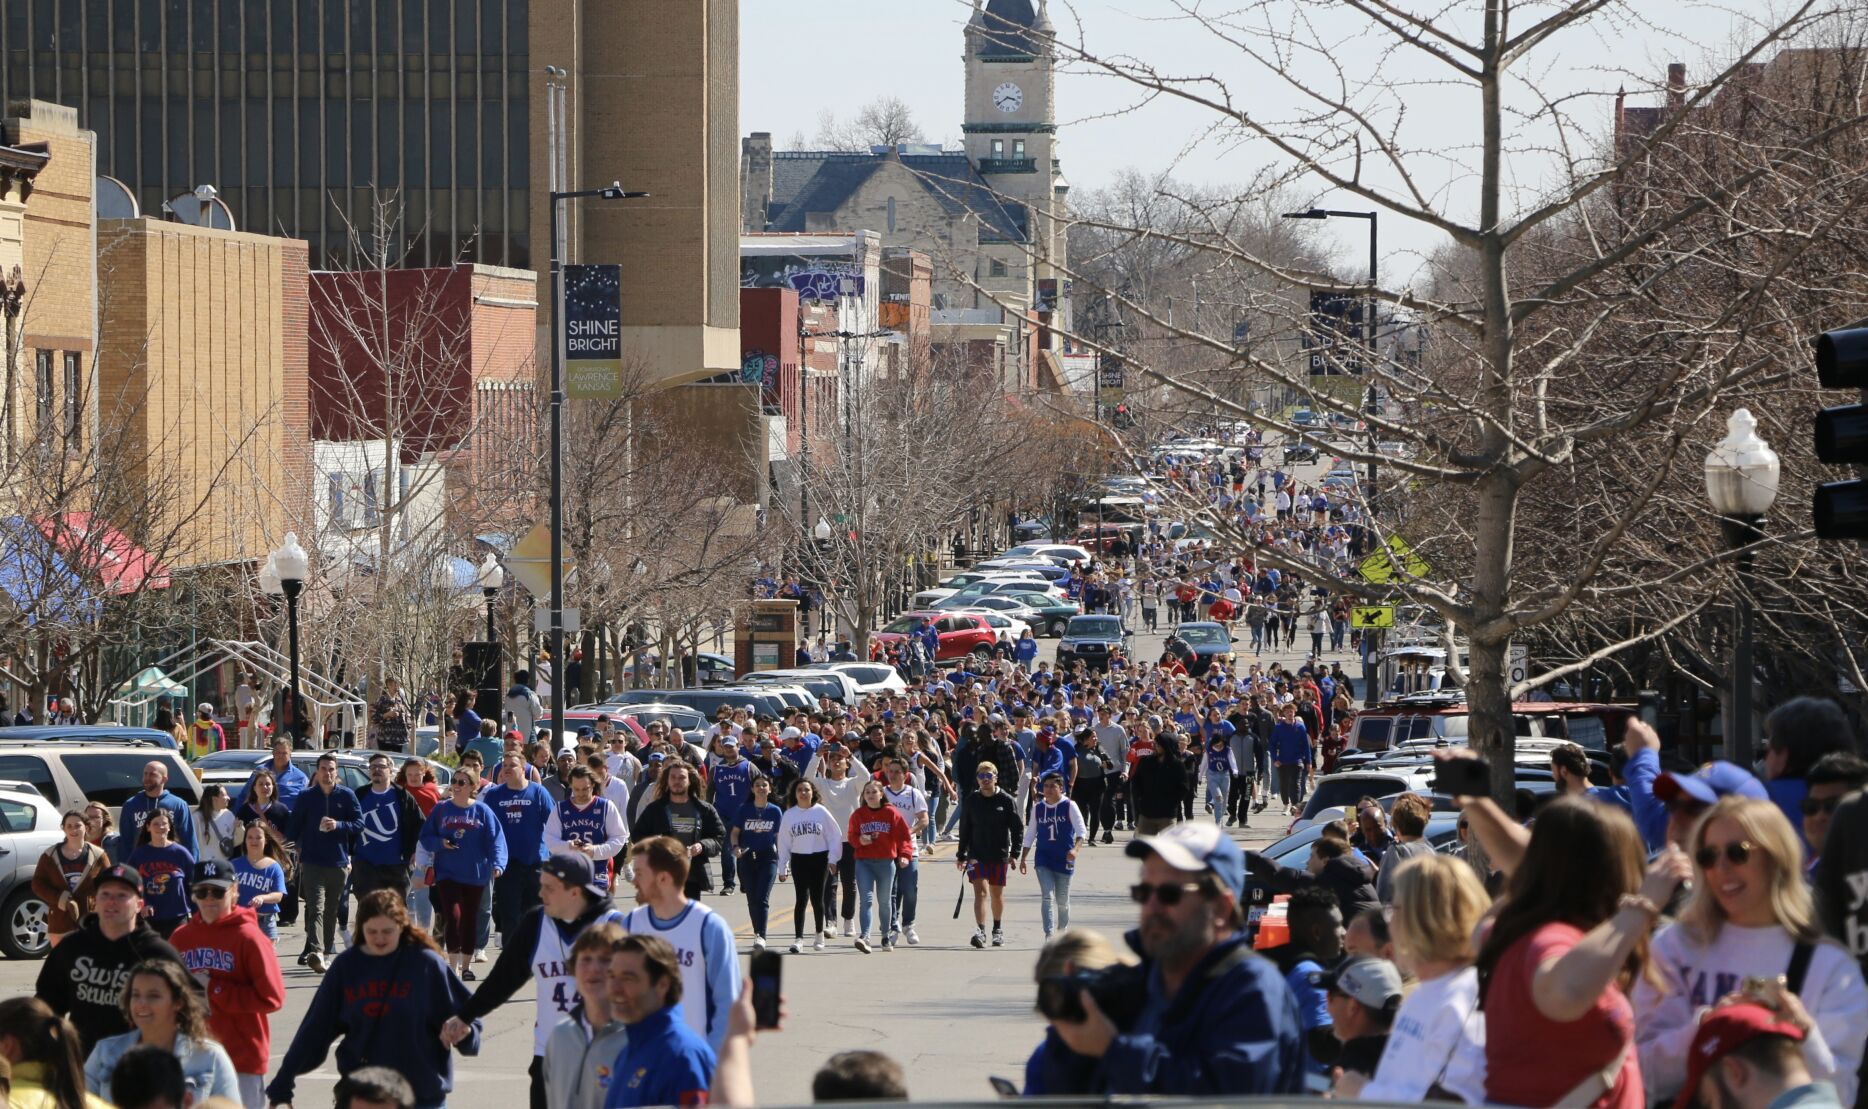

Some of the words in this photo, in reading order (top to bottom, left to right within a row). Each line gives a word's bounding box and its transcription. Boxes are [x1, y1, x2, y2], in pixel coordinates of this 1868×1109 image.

[568, 319, 618, 335] SHINE
[568, 337, 618, 351] BRIGHT
[568, 372, 618, 382] LAWRENCE
[577, 383, 611, 391] KANSAS
[1216, 761, 1224, 772] 0
[718, 774, 745, 783] KANSAS
[728, 782, 737, 796] 1
[499, 799, 532, 807] CREATED
[506, 811, 522, 819] THIS
[1039, 815, 1066, 824] KANSAS
[359, 801, 399, 847] KU
[563, 819, 600, 830] KANSAS
[744, 821, 774, 831] KANSAS
[791, 821, 821, 837] KANSAS
[1047, 824, 1056, 841] 1
